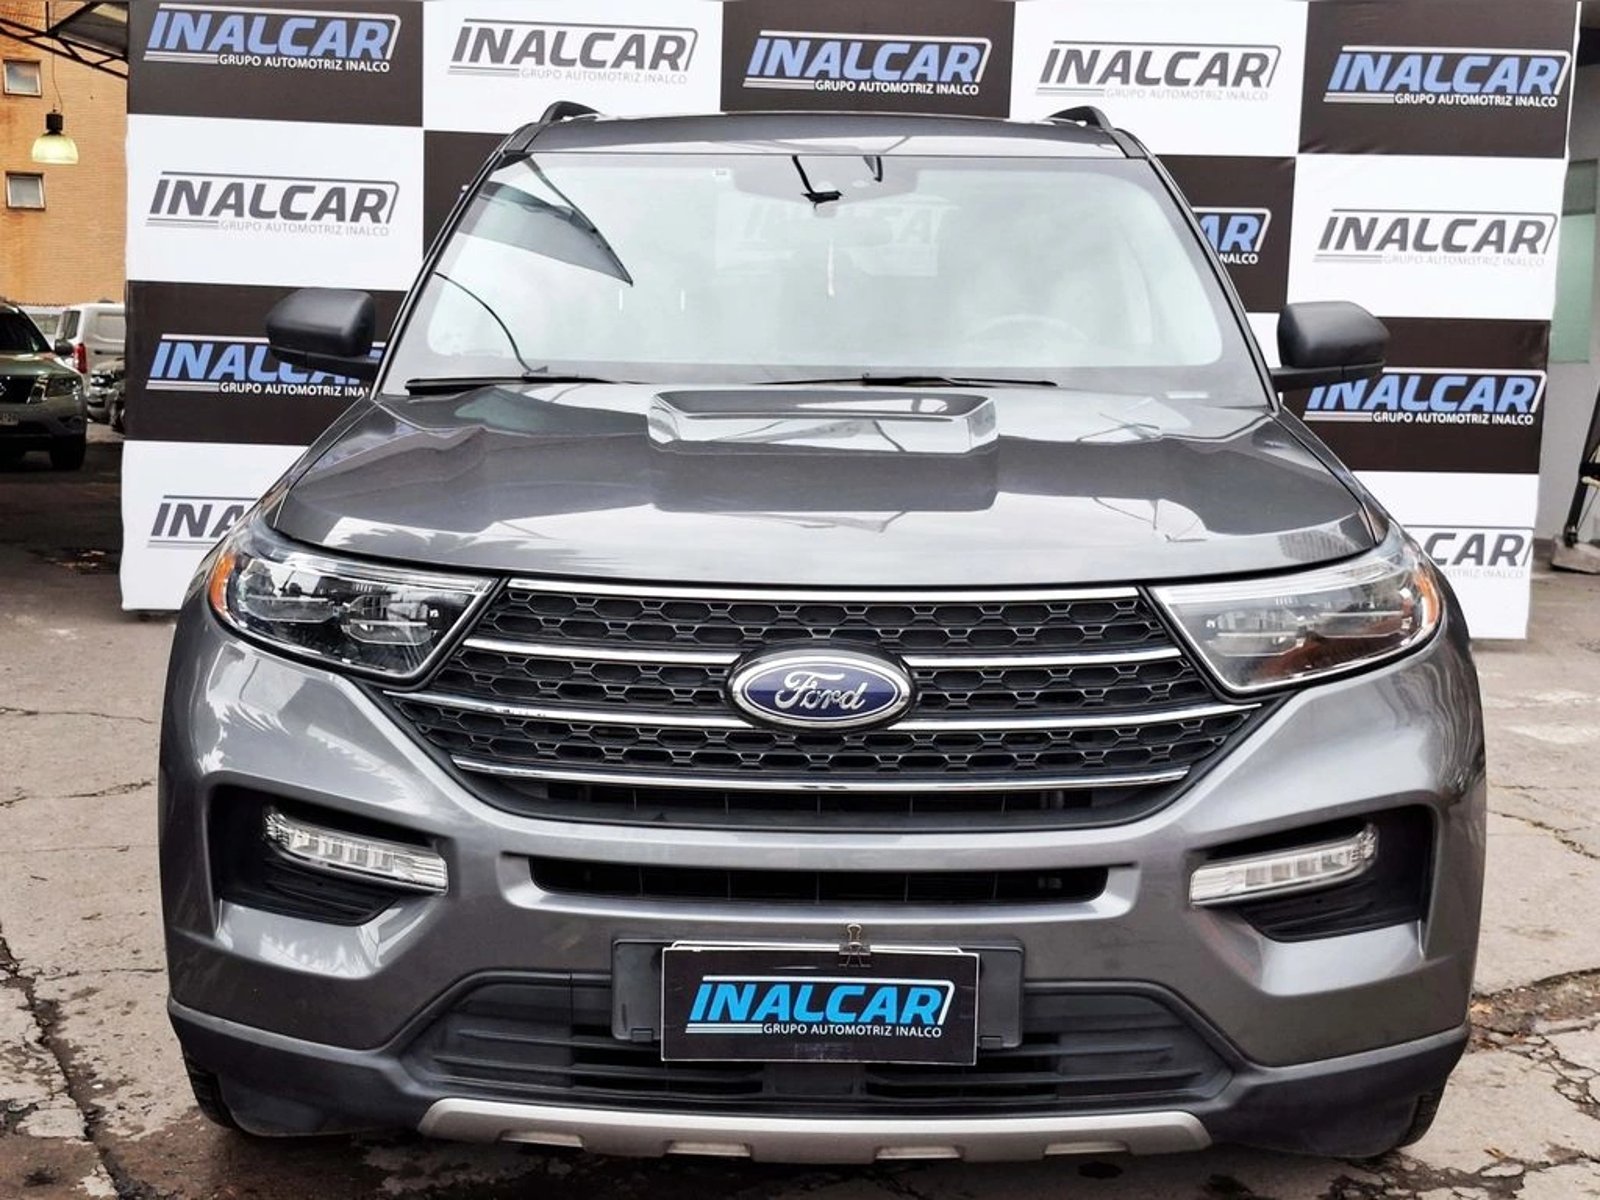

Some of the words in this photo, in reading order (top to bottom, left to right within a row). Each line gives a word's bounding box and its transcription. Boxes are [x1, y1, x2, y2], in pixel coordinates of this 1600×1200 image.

[147, 11, 390, 60] INALCAR
[451, 26, 687, 72] INALCAR
[219, 54, 262, 67] GRUPO
[264, 57, 343, 71] AUTOMOTRIZ
[345, 60, 390, 73] INALCO
[747, 38, 980, 82] INALCAR
[1039, 48, 1270, 88] INALCAR
[1327, 53, 1559, 95] INALCAR
[815, 79, 856, 91] GRUPO
[858, 81, 933, 95] AUTOMOTRIZ
[936, 83, 979, 96] INALCO
[1395, 93, 1435, 105] GRUPO
[1437, 94, 1512, 106] AUTOMOTRIZ
[1515, 96, 1558, 108] INALCO
[150, 179, 388, 224] INALCAR
[1317, 216, 1546, 254] INALCAR
[1220, 253, 1259, 265] NALCO
[150, 342, 382, 385] INAL
[219, 381, 262, 393] GRUPO
[264, 383, 342, 397] AUTOMOTRIZ
[1307, 374, 1536, 413] INALCAR
[1373, 411, 1413, 423] GRUPO
[1415, 412, 1490, 425] AUTOMOTRIZ
[1492, 413, 1534, 425] INALCO
[774, 670, 868, 710] Ford
[689, 983, 942, 1025] INALCAR
[763, 1023, 808, 1034] GRUPO
[810, 1024, 892, 1037] AUTOMOTRIZ
[896, 1025, 942, 1038] INALCO
